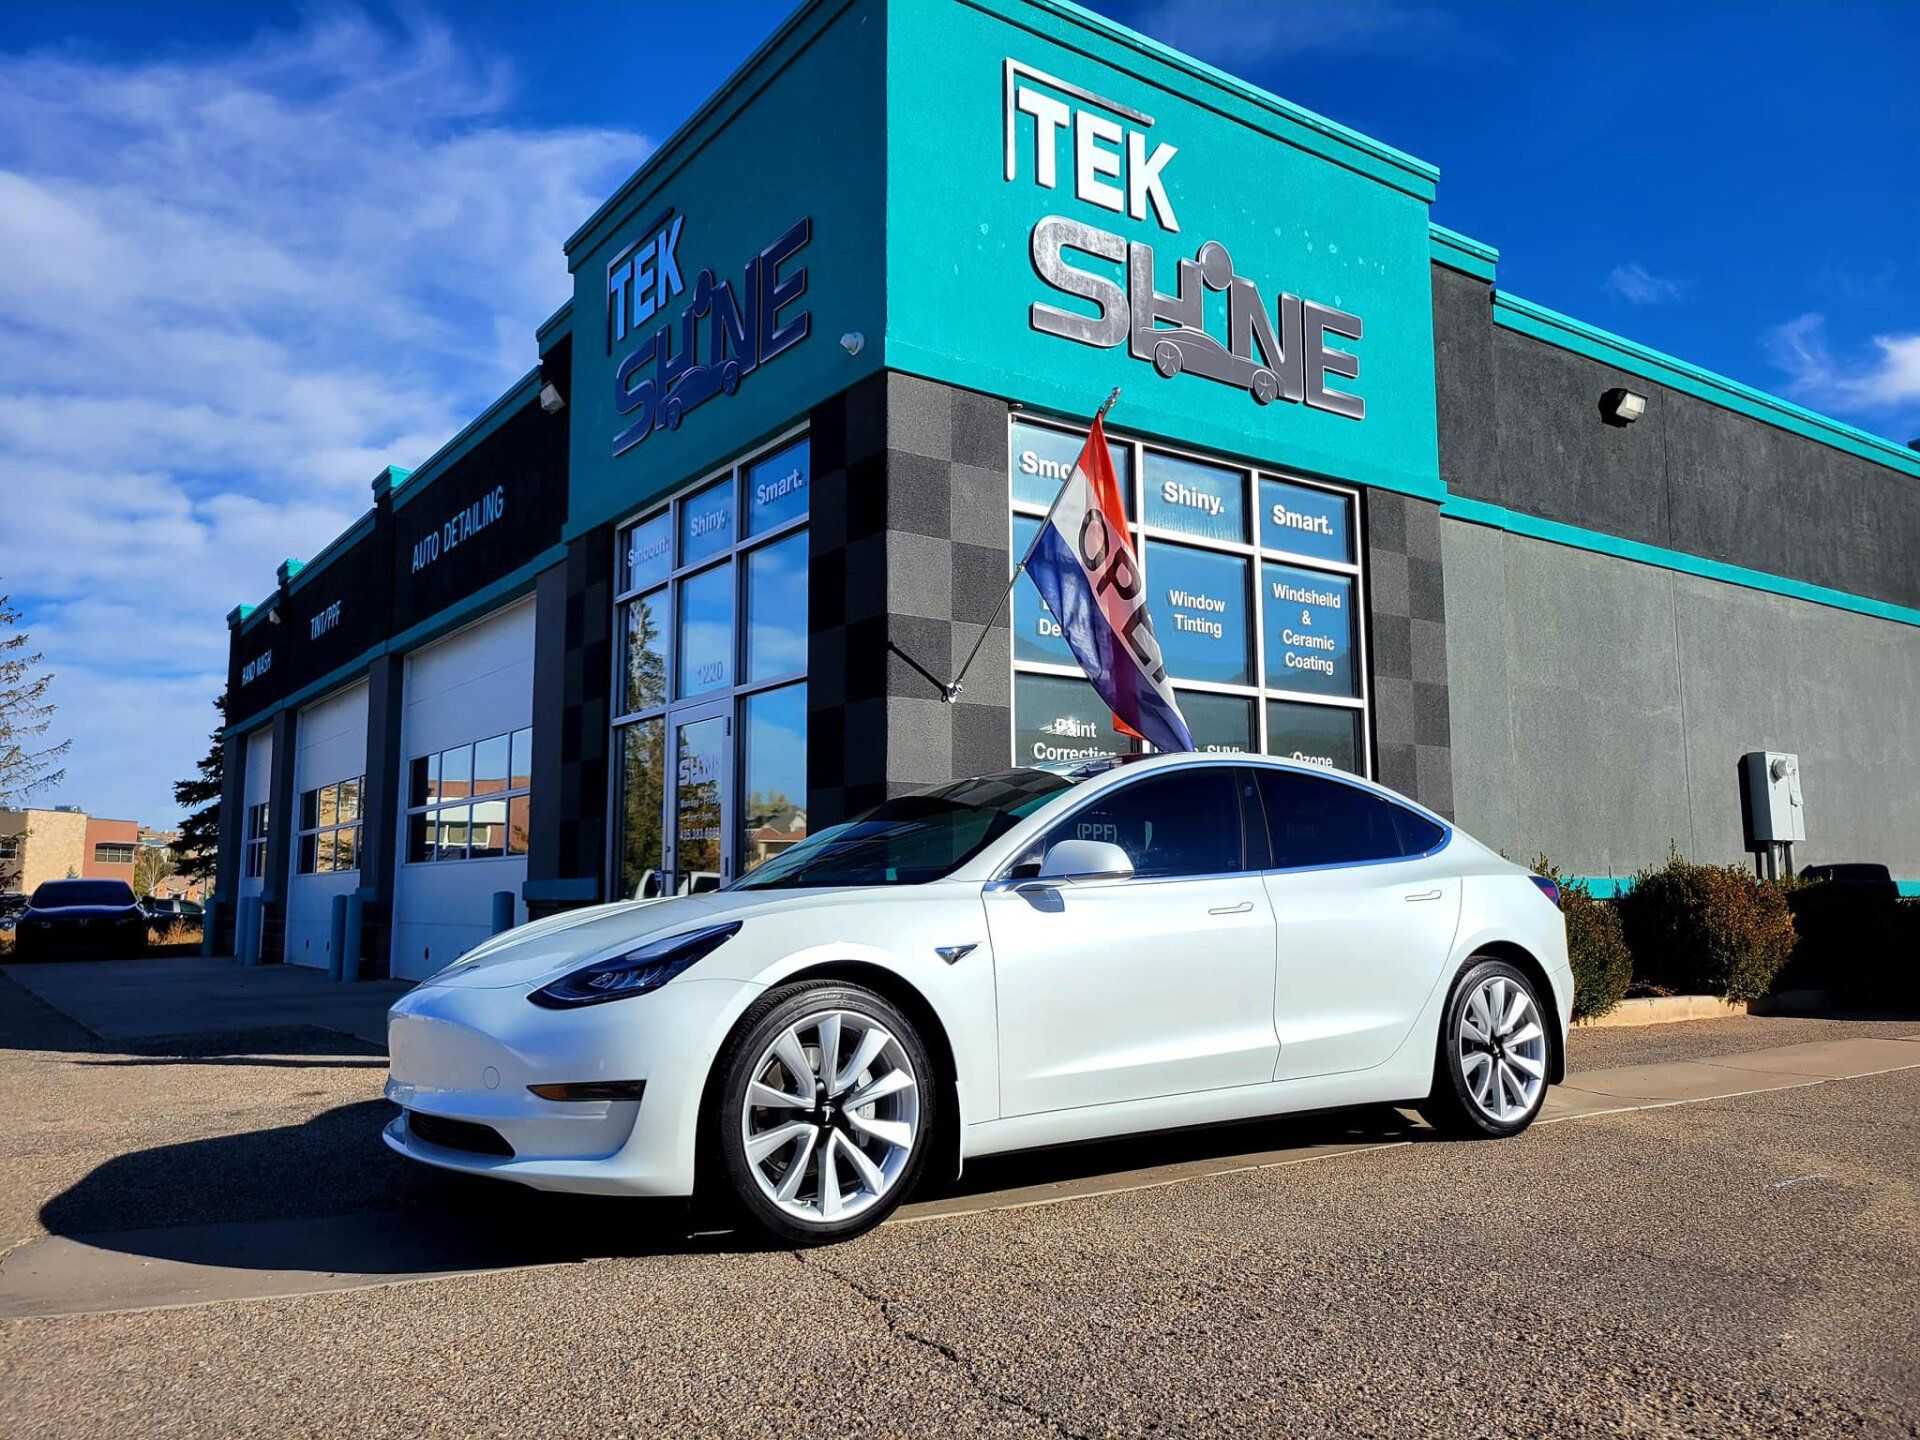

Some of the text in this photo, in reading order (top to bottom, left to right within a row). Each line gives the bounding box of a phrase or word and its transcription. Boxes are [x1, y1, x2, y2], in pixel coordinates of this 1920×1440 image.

[1017, 85, 1181, 234] TEK
[609, 214, 686, 342] TEK
[756, 468, 803, 505] Smart.
[1162, 480, 1226, 515] Shiny.
[411, 485, 505, 574] AUTO DETAILING
[1272, 504, 1335, 536] Smart.
[1170, 589, 1226, 613] Window
[1272, 582, 1341, 609] Windsheild
[1174, 613, 1223, 638] Tinting
[1301, 611, 1312, 625] &
[1282, 629, 1335, 652] Ceramic
[1285, 651, 1334, 676] Coating
[1077, 822, 1117, 843] (PPF)
